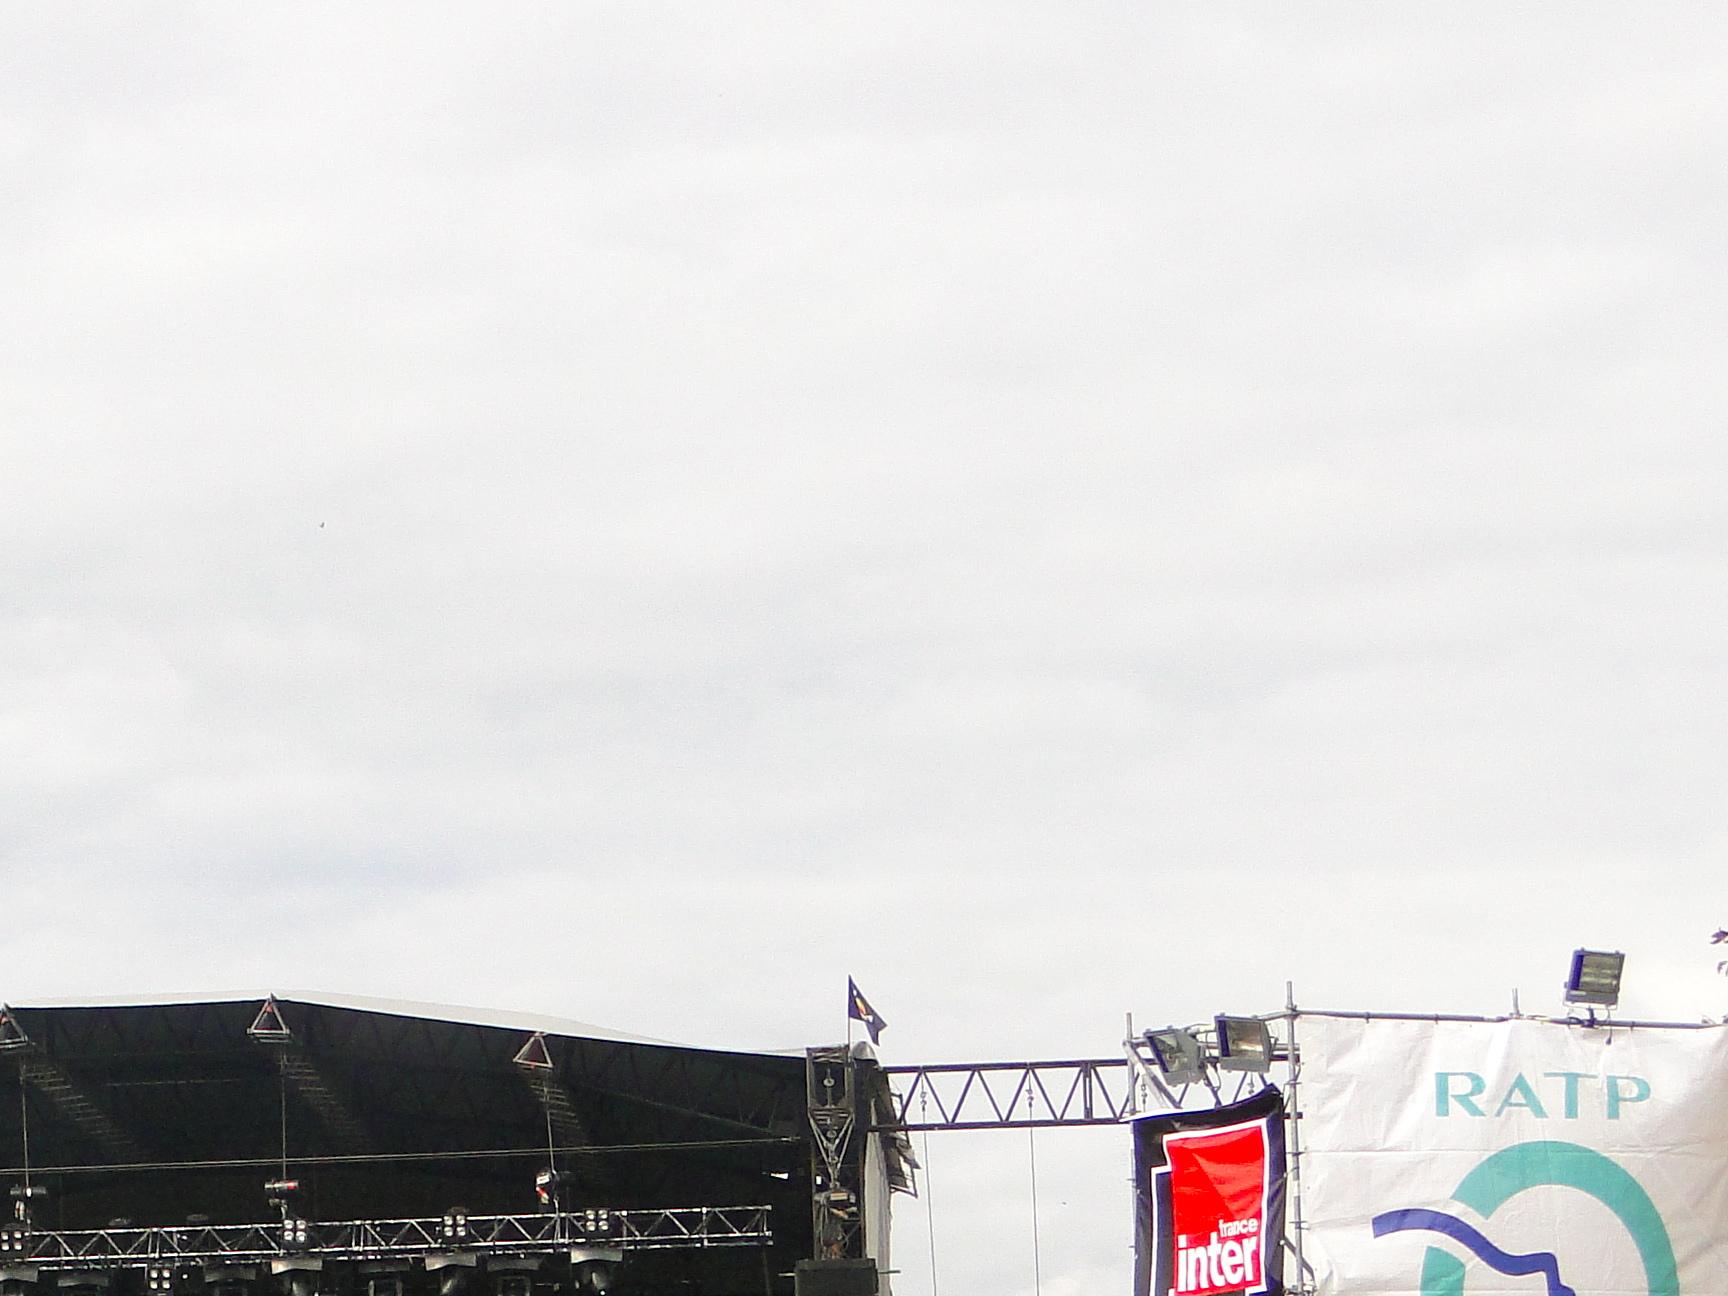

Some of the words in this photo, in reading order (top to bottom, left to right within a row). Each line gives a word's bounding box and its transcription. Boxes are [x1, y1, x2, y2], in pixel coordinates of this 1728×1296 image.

[1434, 1071, 1651, 1120] RATP
[1218, 1218, 1259, 1238] france
[1177, 1231, 1257, 1292] inter
